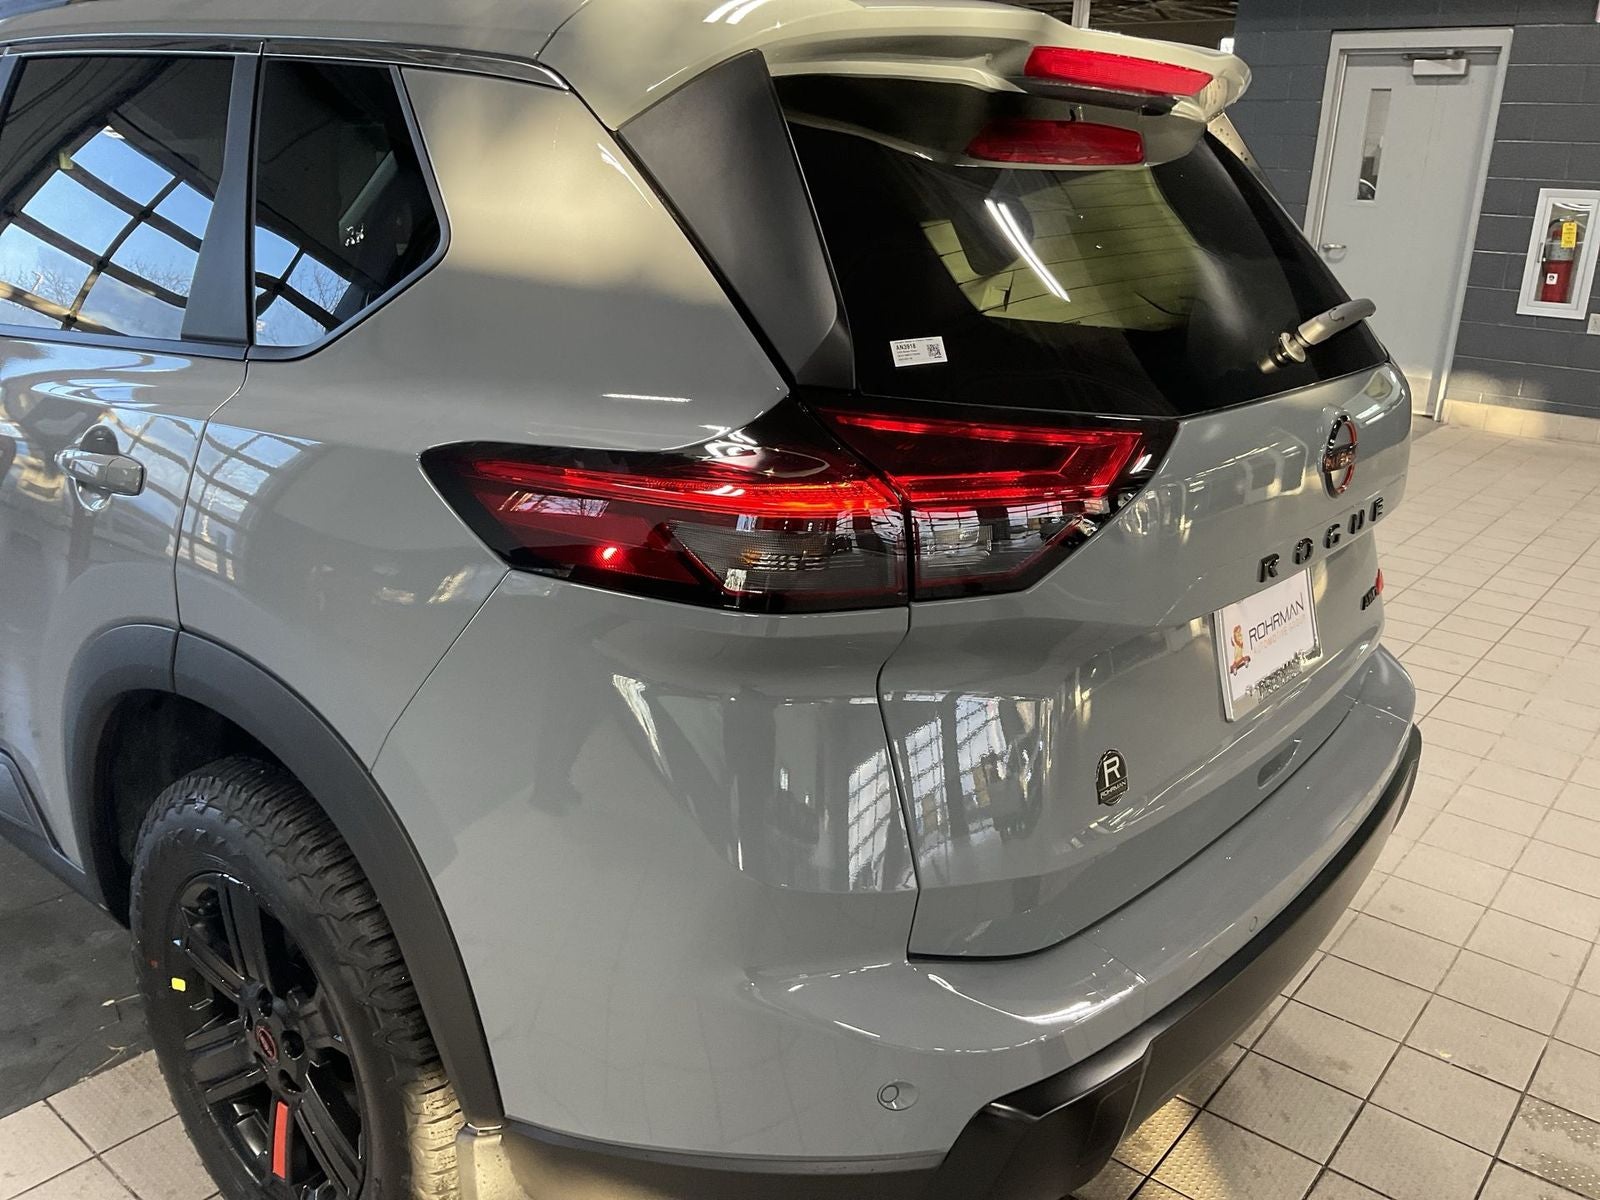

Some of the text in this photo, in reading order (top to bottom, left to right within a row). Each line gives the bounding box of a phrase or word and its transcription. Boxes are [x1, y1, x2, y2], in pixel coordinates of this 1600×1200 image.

[1257, 497, 1384, 583] ROGUE
[1248, 591, 1305, 651] ROHRMAN
[1103, 756, 1121, 788] R
